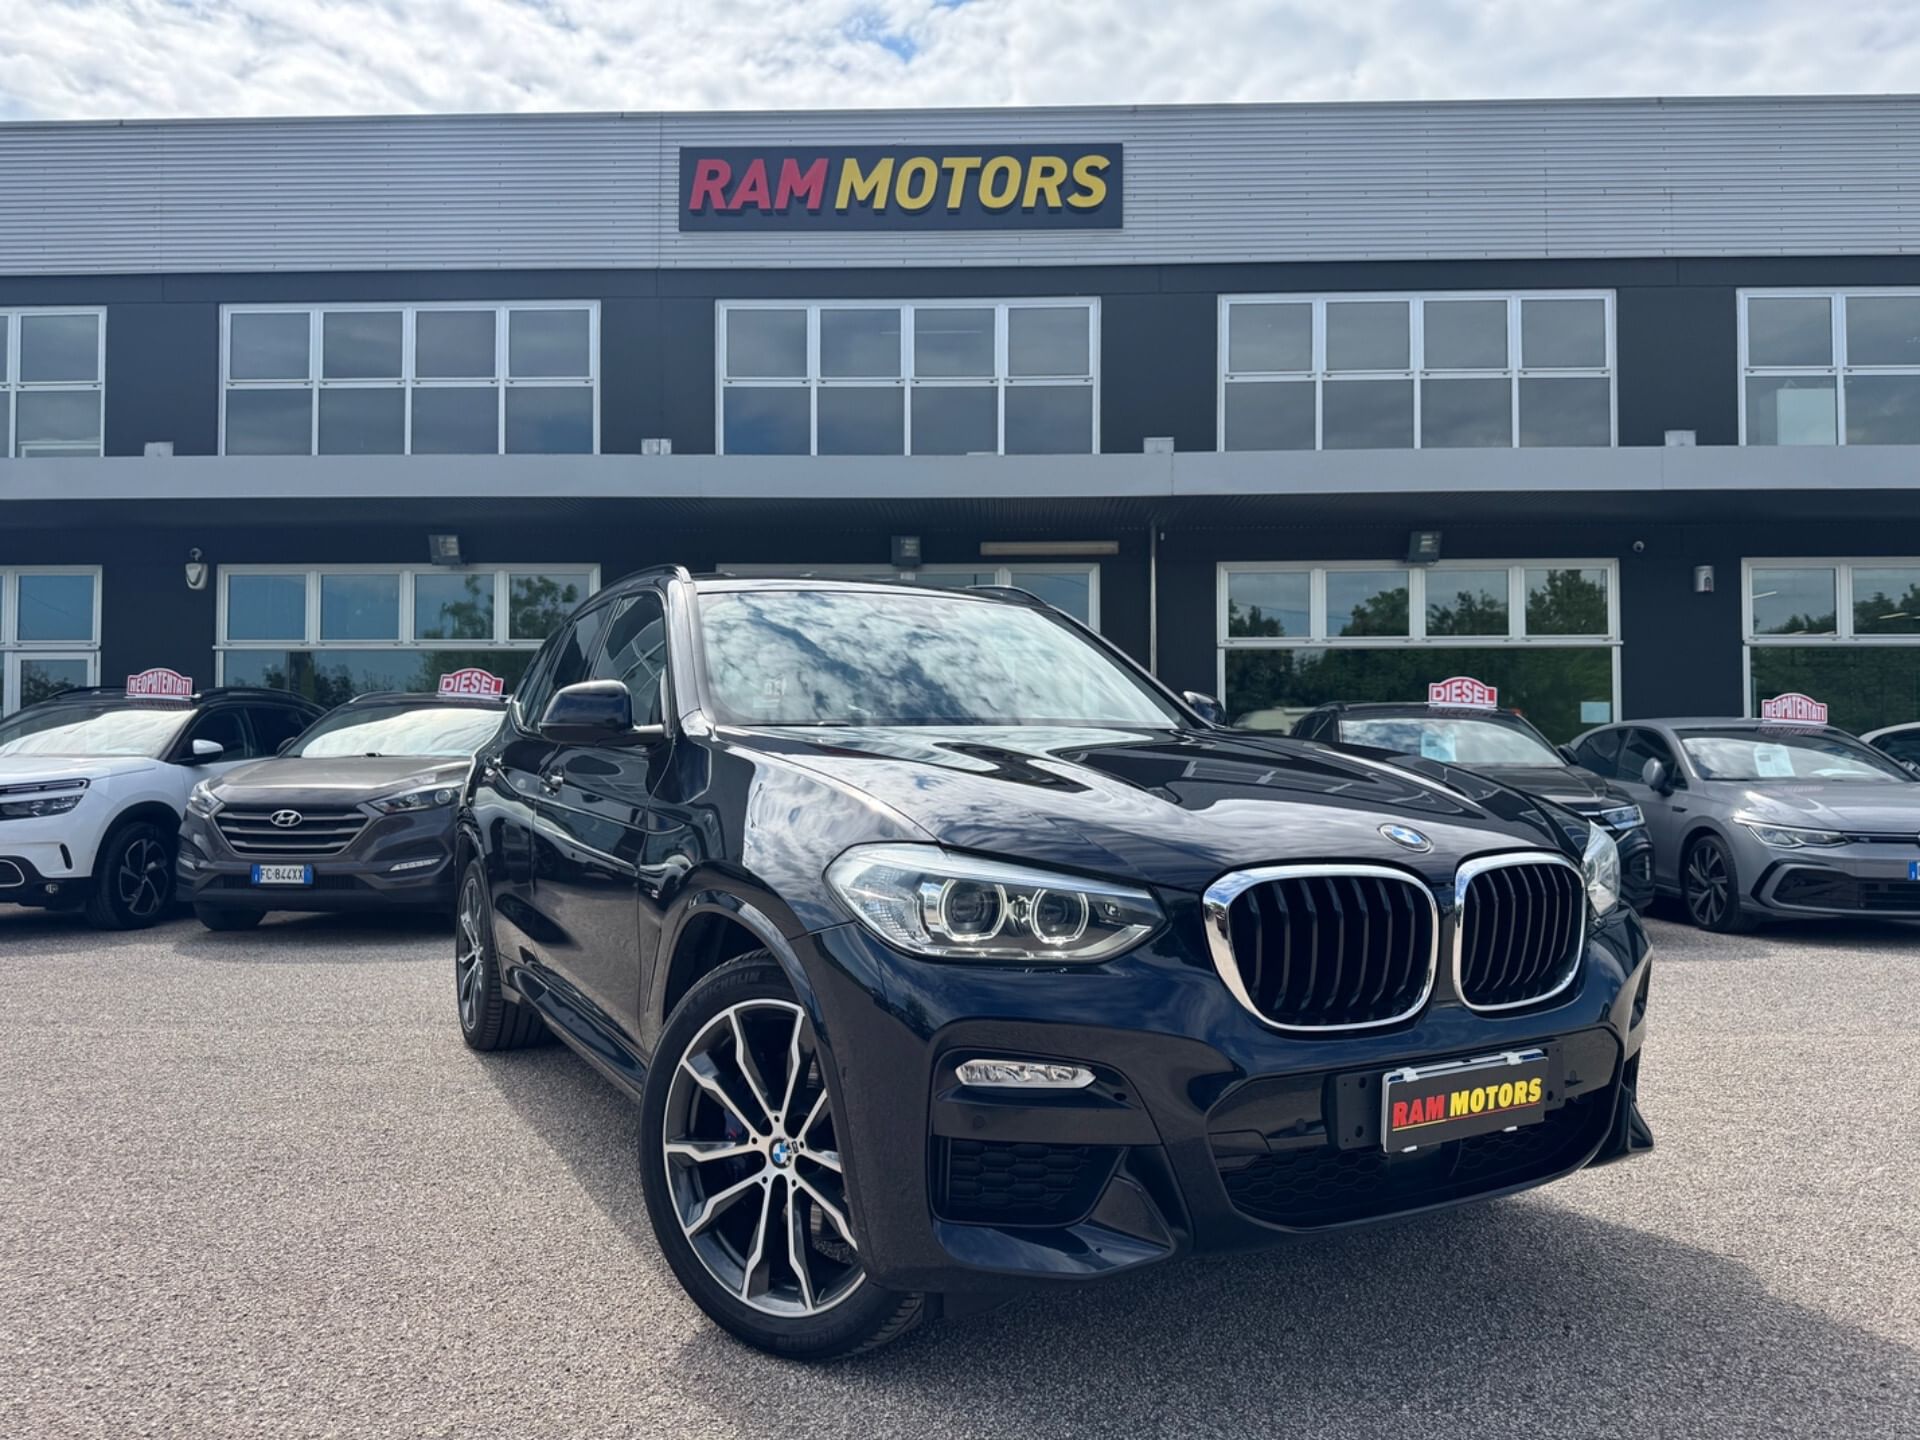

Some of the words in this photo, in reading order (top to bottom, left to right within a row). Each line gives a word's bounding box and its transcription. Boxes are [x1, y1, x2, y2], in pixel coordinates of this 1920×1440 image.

[688, 157, 829, 211] RAM
[834, 154, 1111, 212] MOTORS
[129, 671, 190, 694] NEOPATENTATI
[441, 672, 499, 694] DIESEL
[1432, 681, 1495, 704] DIESEL
[1764, 695, 1825, 721] NEOPATENTATI
[1392, 1094, 1445, 1128] RAM
[1450, 1077, 1542, 1117] MOTORS
